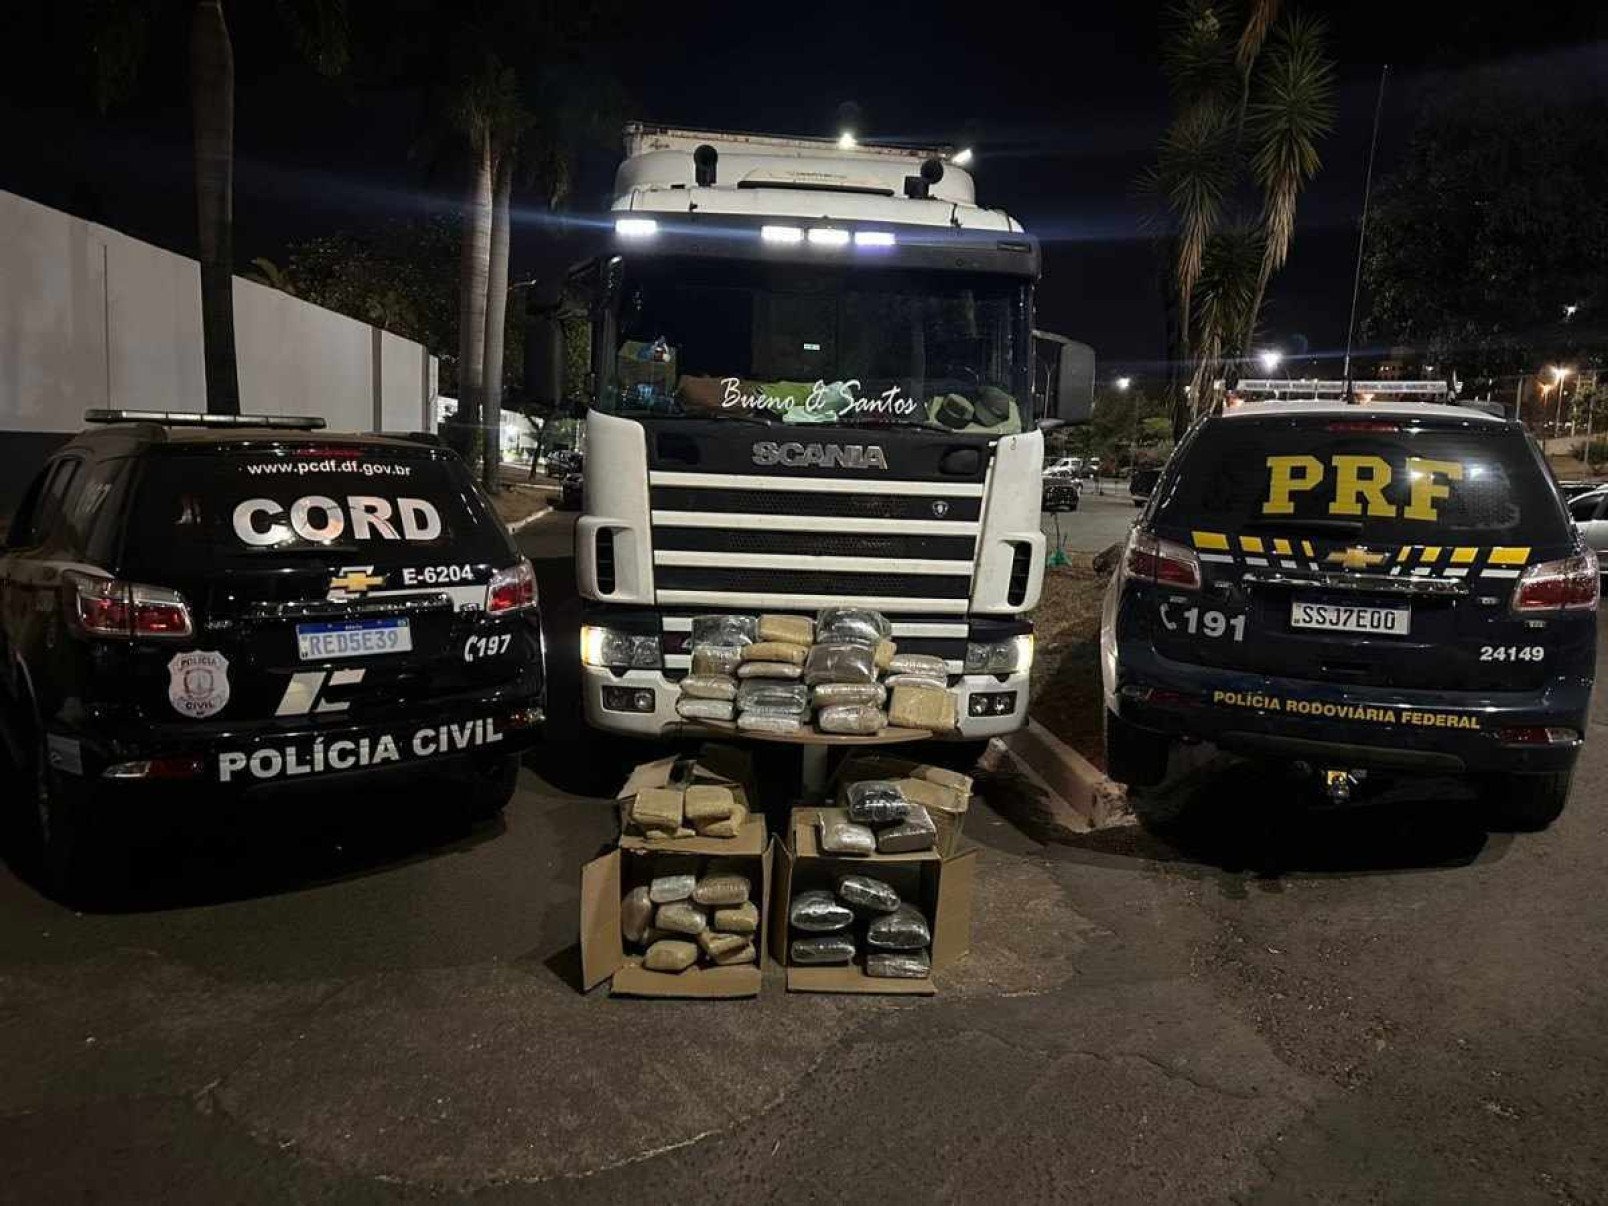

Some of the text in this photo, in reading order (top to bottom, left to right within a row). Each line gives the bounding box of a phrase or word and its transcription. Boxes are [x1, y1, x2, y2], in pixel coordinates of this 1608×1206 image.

[720, 377, 794, 409] Bueno
[838, 379, 918, 416] Santos
[247, 460, 411, 476] www.pcdf.df.gov.br
[752, 441, 888, 470] SCANIA
[1262, 454, 1463, 521] PRF
[233, 495, 442, 546] CORD
[402, 563, 474, 585] E-6204
[1183, 607, 1246, 641] 191
[1302, 605, 1396, 631] SSJ7E00
[309, 630, 399, 656] RED5E39
[477, 633, 512, 658] 197
[1480, 646, 1545, 661] 24149
[1213, 690, 1281, 710] POLÍCIA
[1401, 711, 1481, 730] FEDERAL
[218, 717, 504, 782] POLÍCIA CIVIL
